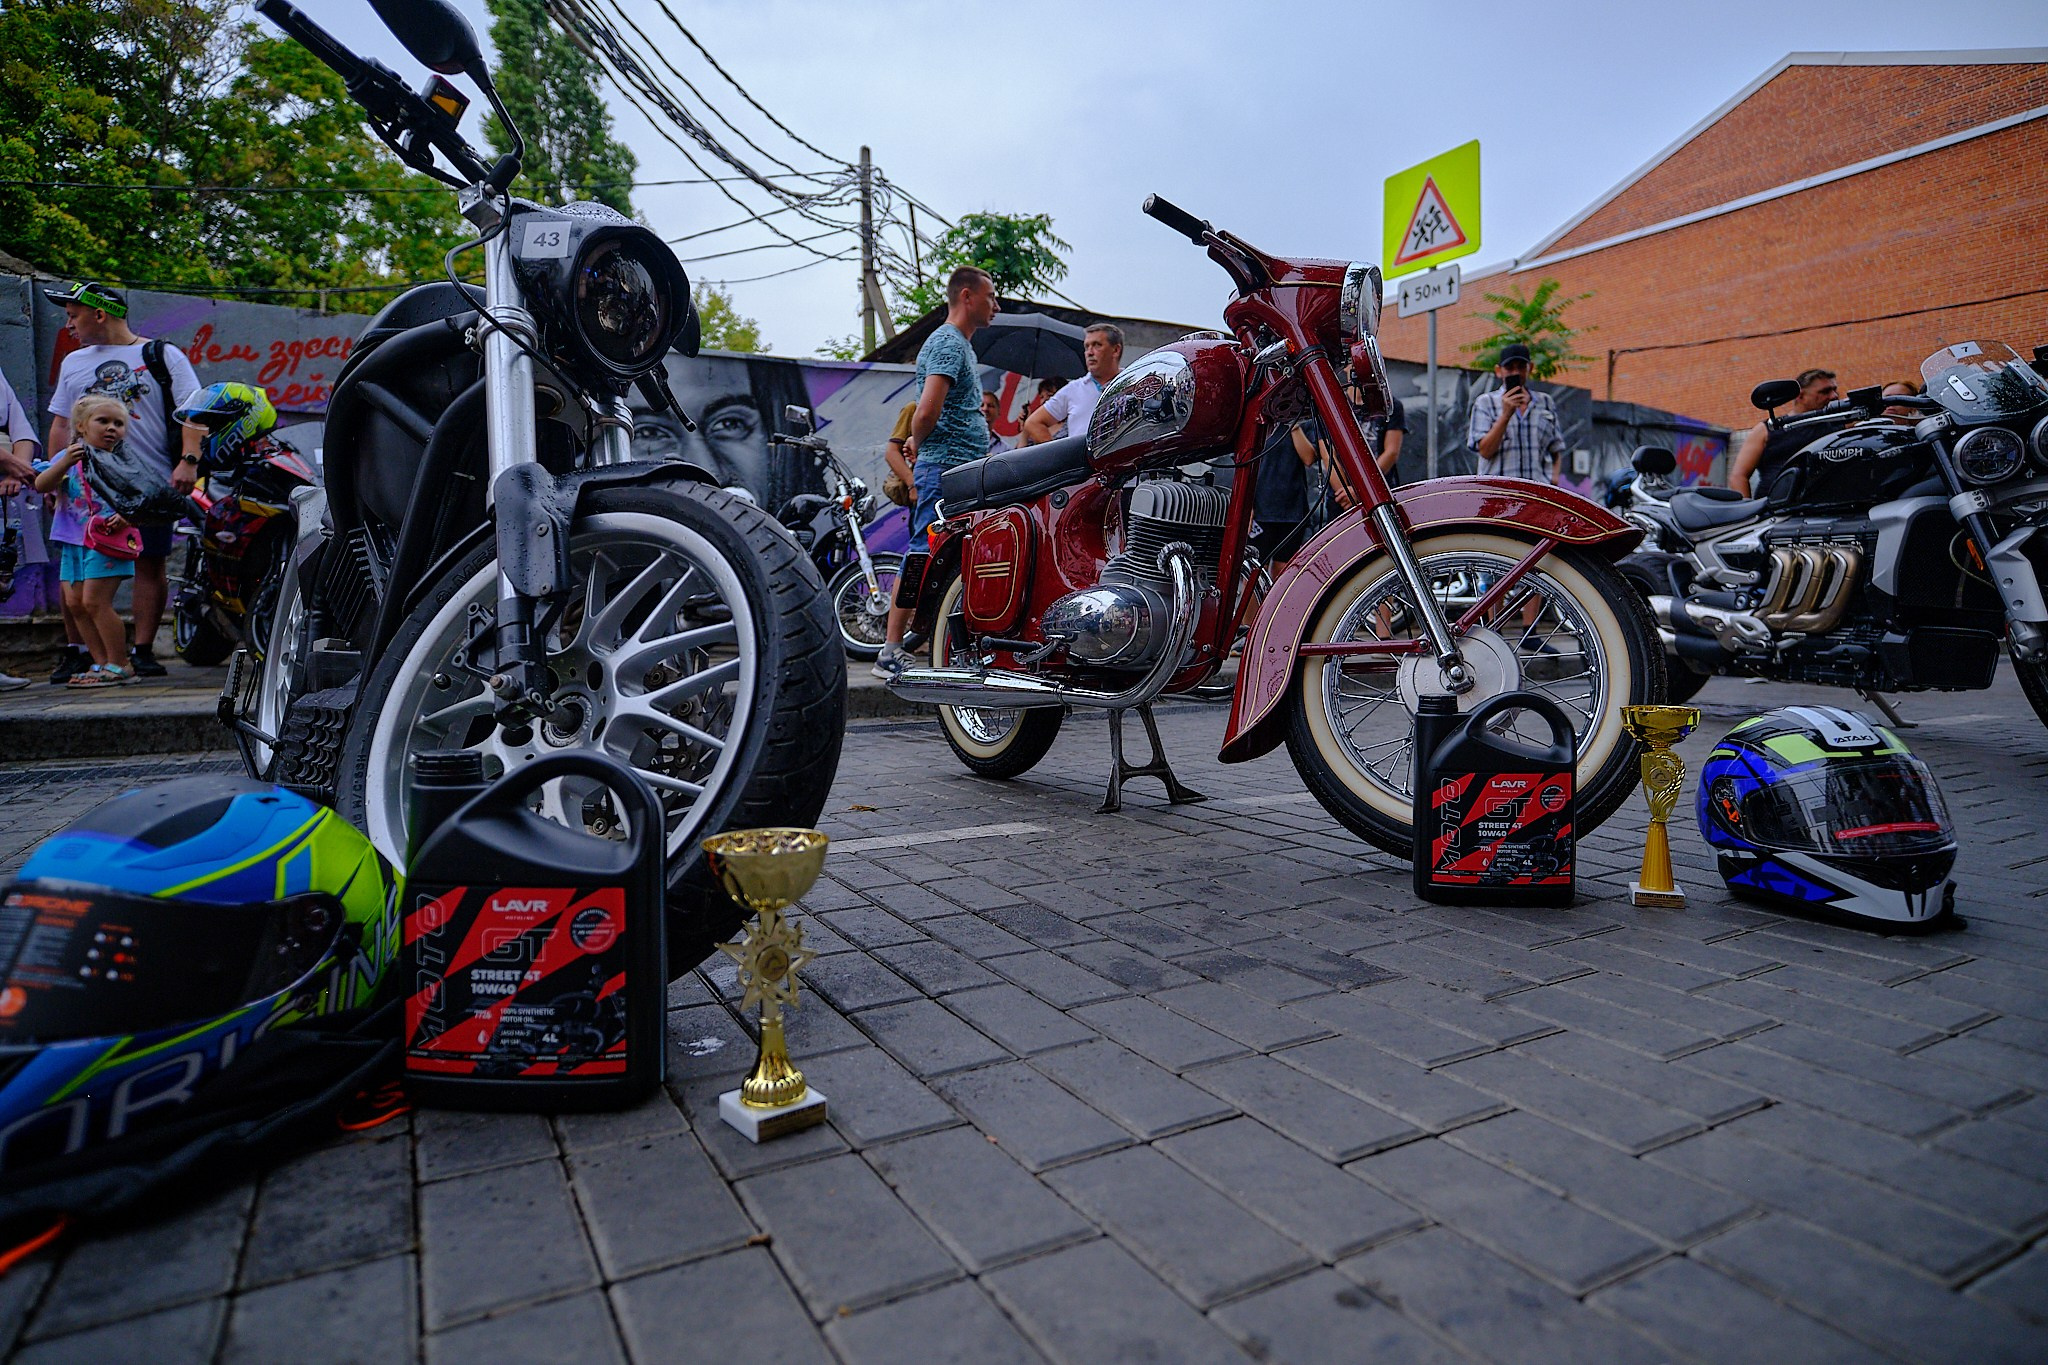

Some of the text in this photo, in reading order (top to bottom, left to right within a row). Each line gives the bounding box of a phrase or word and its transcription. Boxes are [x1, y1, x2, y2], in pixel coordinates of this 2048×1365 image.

[533, 232, 560, 248] 43
[96, 297, 122, 314] YAMAHA
[1961, 345, 1969, 354] 7
[1817, 447, 1864, 463] TRIUMPH
[1835, 735, 1874, 744] ATAKI
[1491, 780, 1528, 788] LAVR
[1484, 797, 1533, 818] GT
[492, 899, 548, 912] LAVR
[481, 928, 558, 963] GT
[470, 969, 542, 982] STREET 4T
[470, 983, 516, 995] 10W40
[517, 1007, 555, 1016] SYNTHETIC
[499, 1015, 534, 1023] MOTOR OIL
[541, 1032, 560, 1043] 4L
